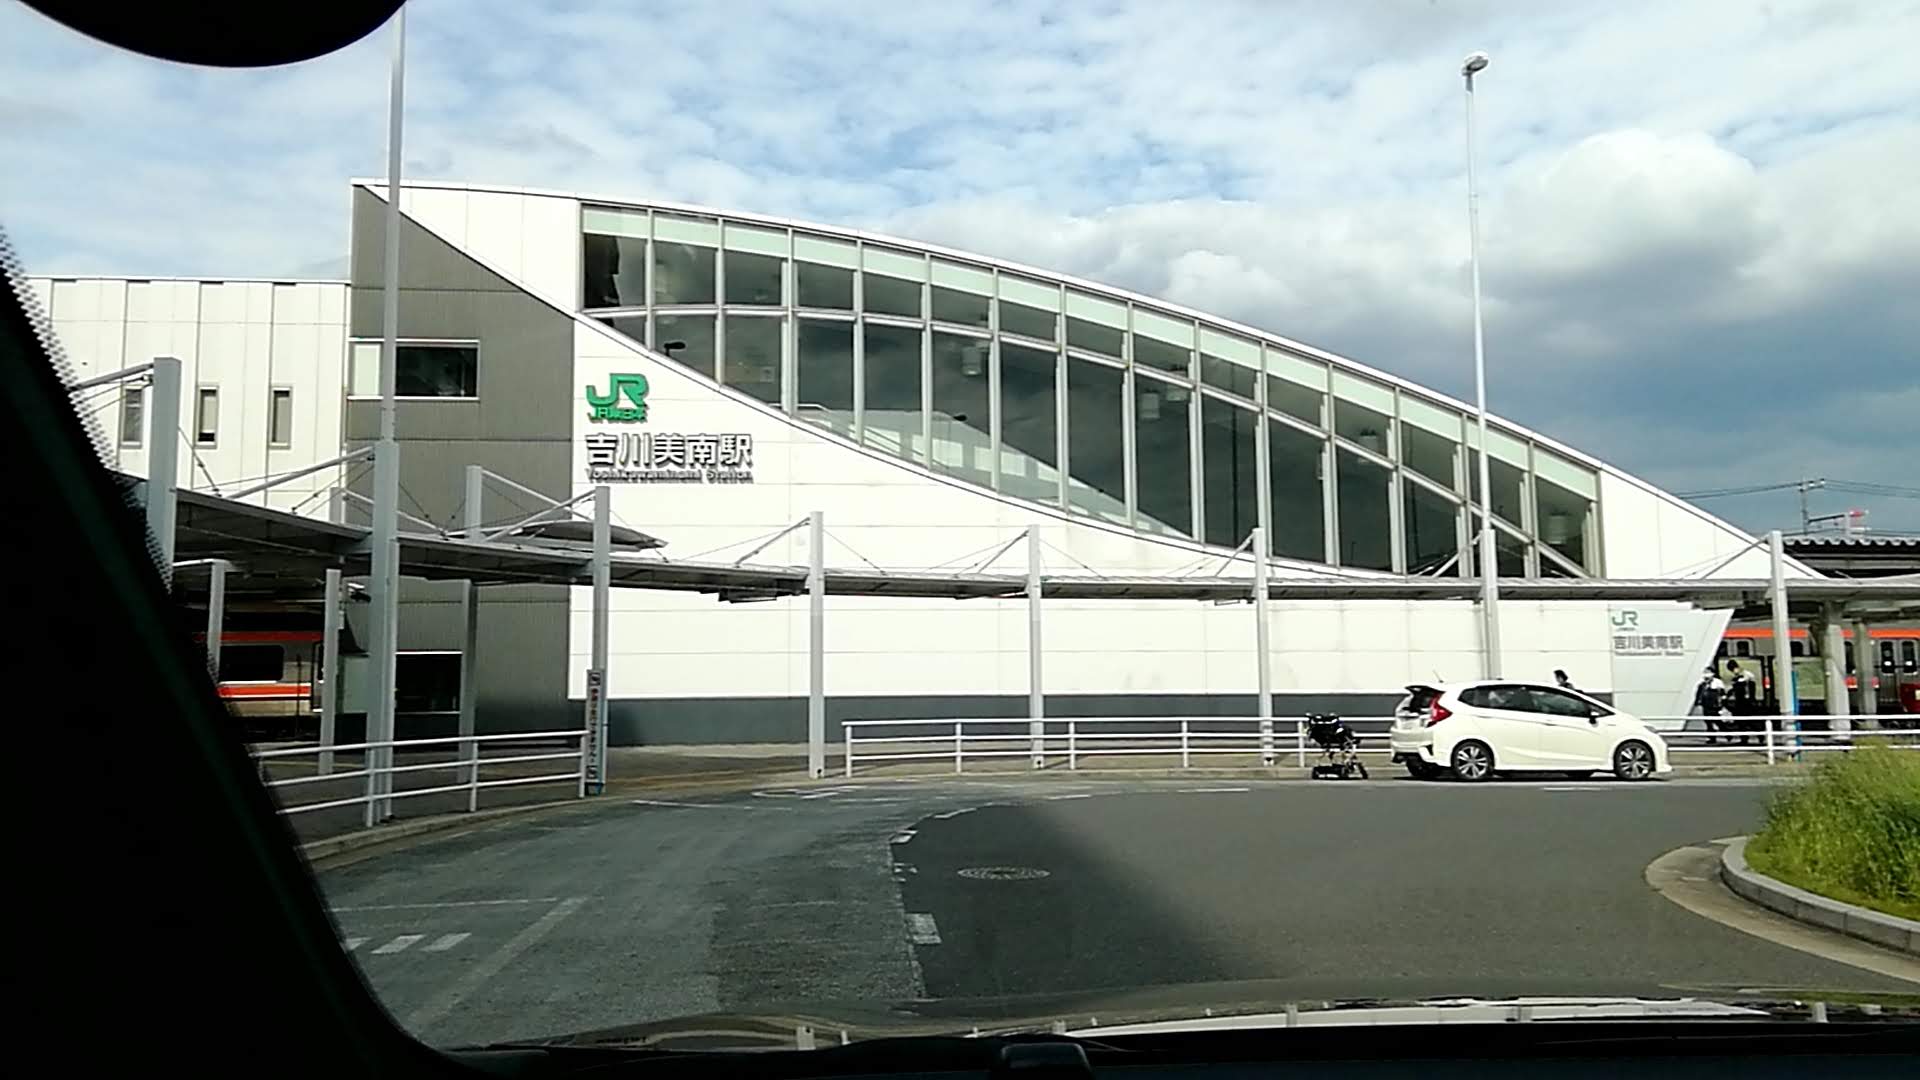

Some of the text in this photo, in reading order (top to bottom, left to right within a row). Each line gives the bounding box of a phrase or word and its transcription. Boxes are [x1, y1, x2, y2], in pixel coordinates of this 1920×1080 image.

[586, 373, 649, 407] JR
[585, 433, 752, 468] 吉川美南駅
[706, 467, 754, 484] Station
[1611, 610, 1639, 626] JR
